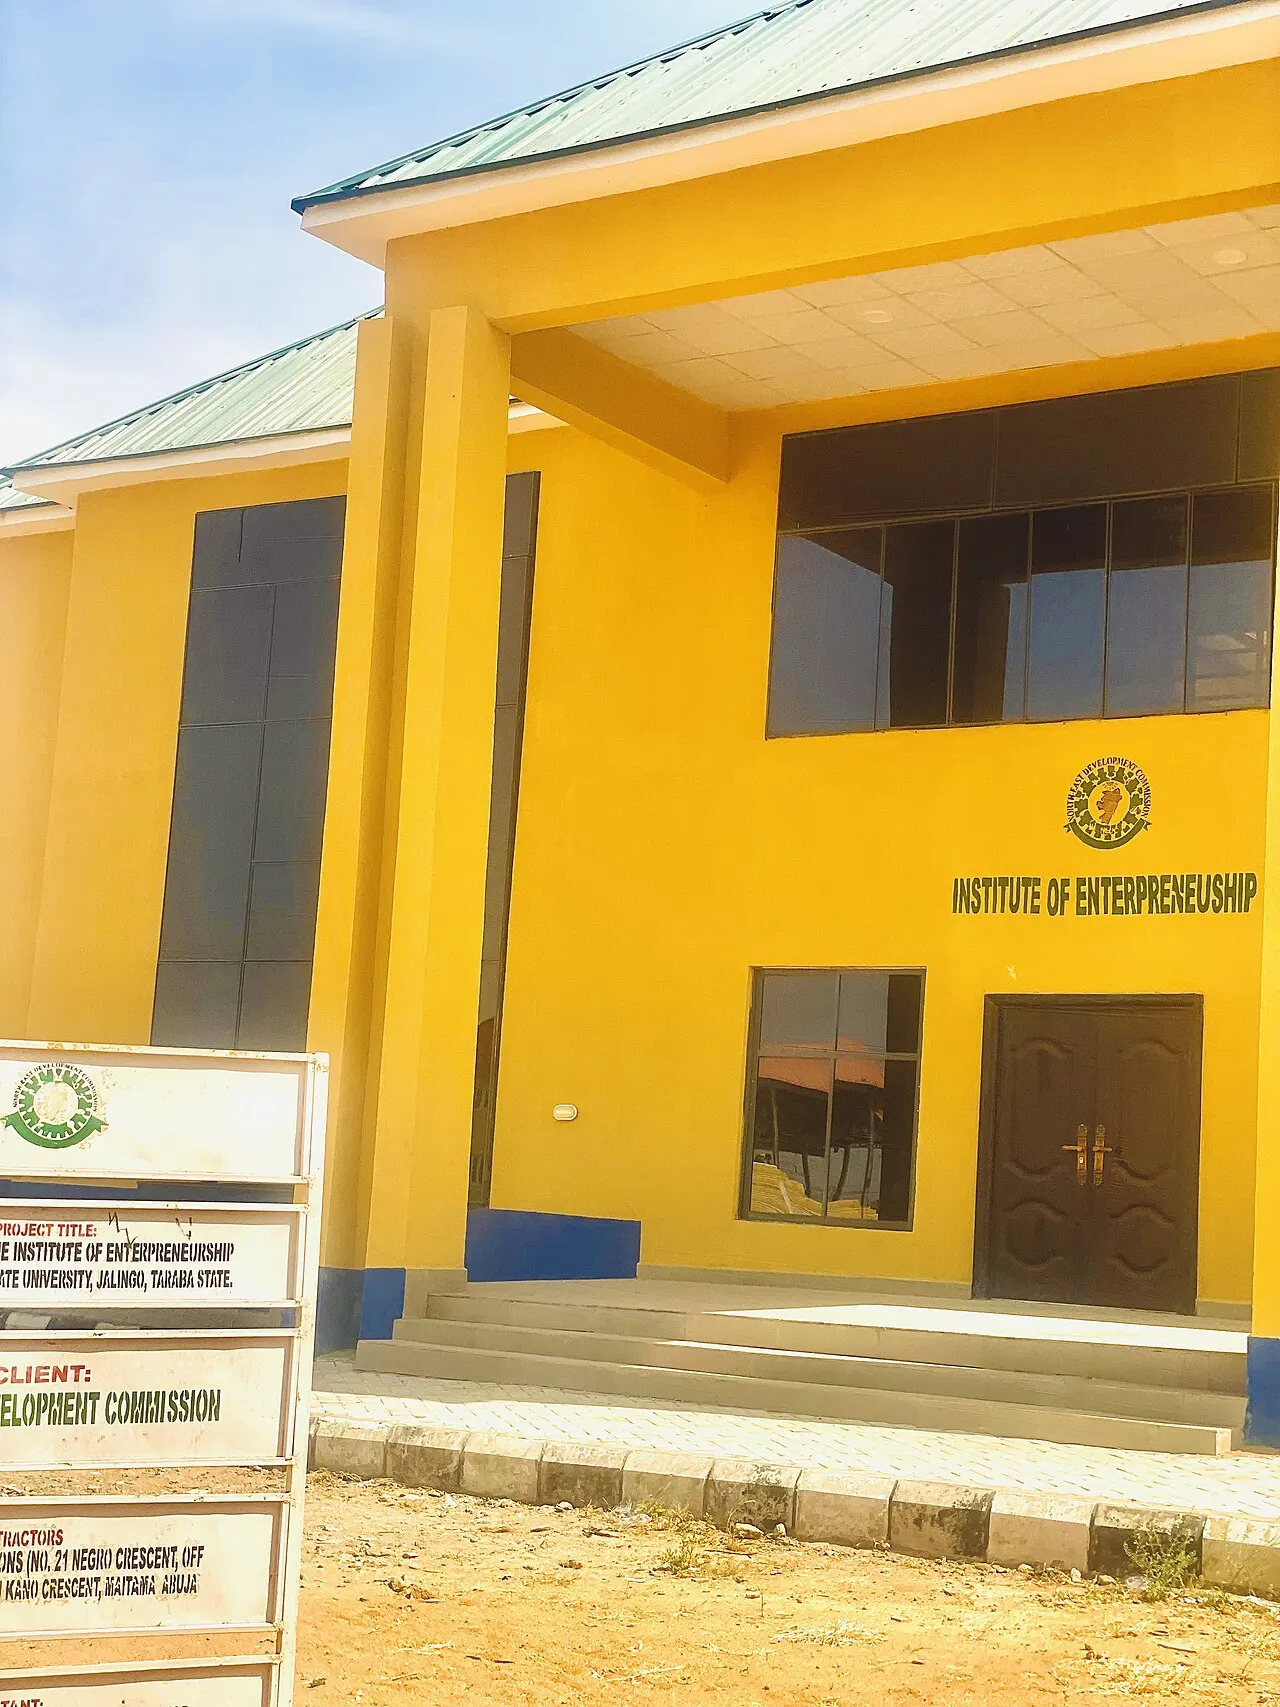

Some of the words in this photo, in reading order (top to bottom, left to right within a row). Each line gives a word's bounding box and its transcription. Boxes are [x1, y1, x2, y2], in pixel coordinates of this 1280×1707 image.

[1082, 756, 1138, 775] DEVELOPMENT
[1135, 769, 1152, 818] COMMISSION
[952, 876, 1041, 914] INSTITUTE
[1047, 877, 1070, 917] OF
[1075, 872, 1258, 916] ENTERPRENEUSHIP
[57, 1223, 97, 1237] TITLE:
[13, 1241, 82, 1262] INSTITUTE
[86, 1242, 103, 1262] OF
[106, 1242, 235, 1263] ENTERPRENEURSHIP
[22, 1269, 93, 1292] UNIVERSITY,
[96, 1270, 147, 1292] JALINGO,
[150, 1270, 194, 1289] TARABA
[197, 1270, 233, 1288] STATE.
[105, 1389, 221, 1425] COMMISSION
[26, 1549, 51, 1578] (NO.
[54, 1549, 68, 1571] 21
[72, 1548, 112, 1571] NEGRO
[115, 1546, 178, 1572] CRESCENT,
[182, 1545, 204, 1568] OFF
[5, 1579, 39, 1600] KANO
[42, 1576, 101, 1600] CRESCENT,
[104, 1575, 156, 1597] MAITAMA
[161, 1573, 197, 1595] ABUJA
